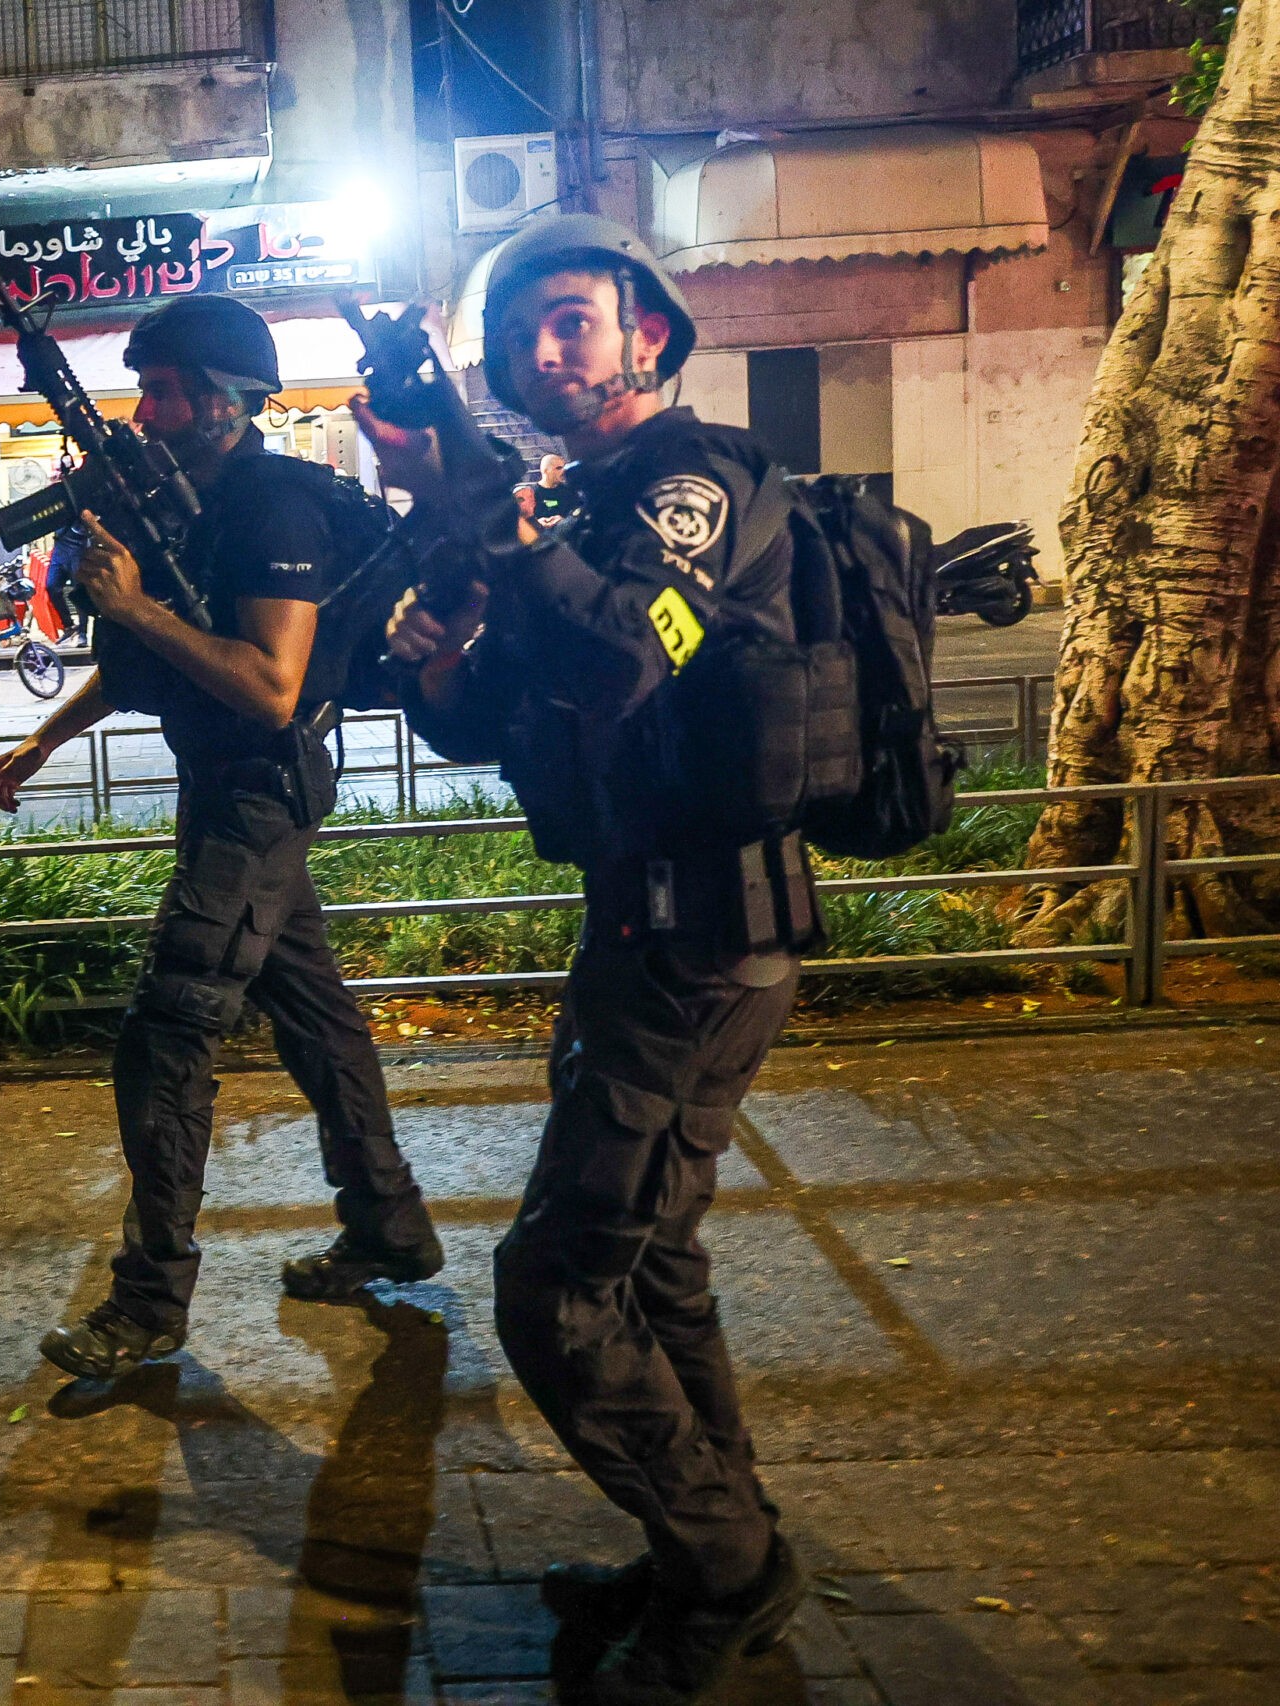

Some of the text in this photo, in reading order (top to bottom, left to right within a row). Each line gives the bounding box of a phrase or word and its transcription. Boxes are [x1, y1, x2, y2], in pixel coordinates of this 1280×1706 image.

[116, 218, 173, 263] بالي
[235, 269, 270, 284] שנה
[272, 267, 293, 282] 35
